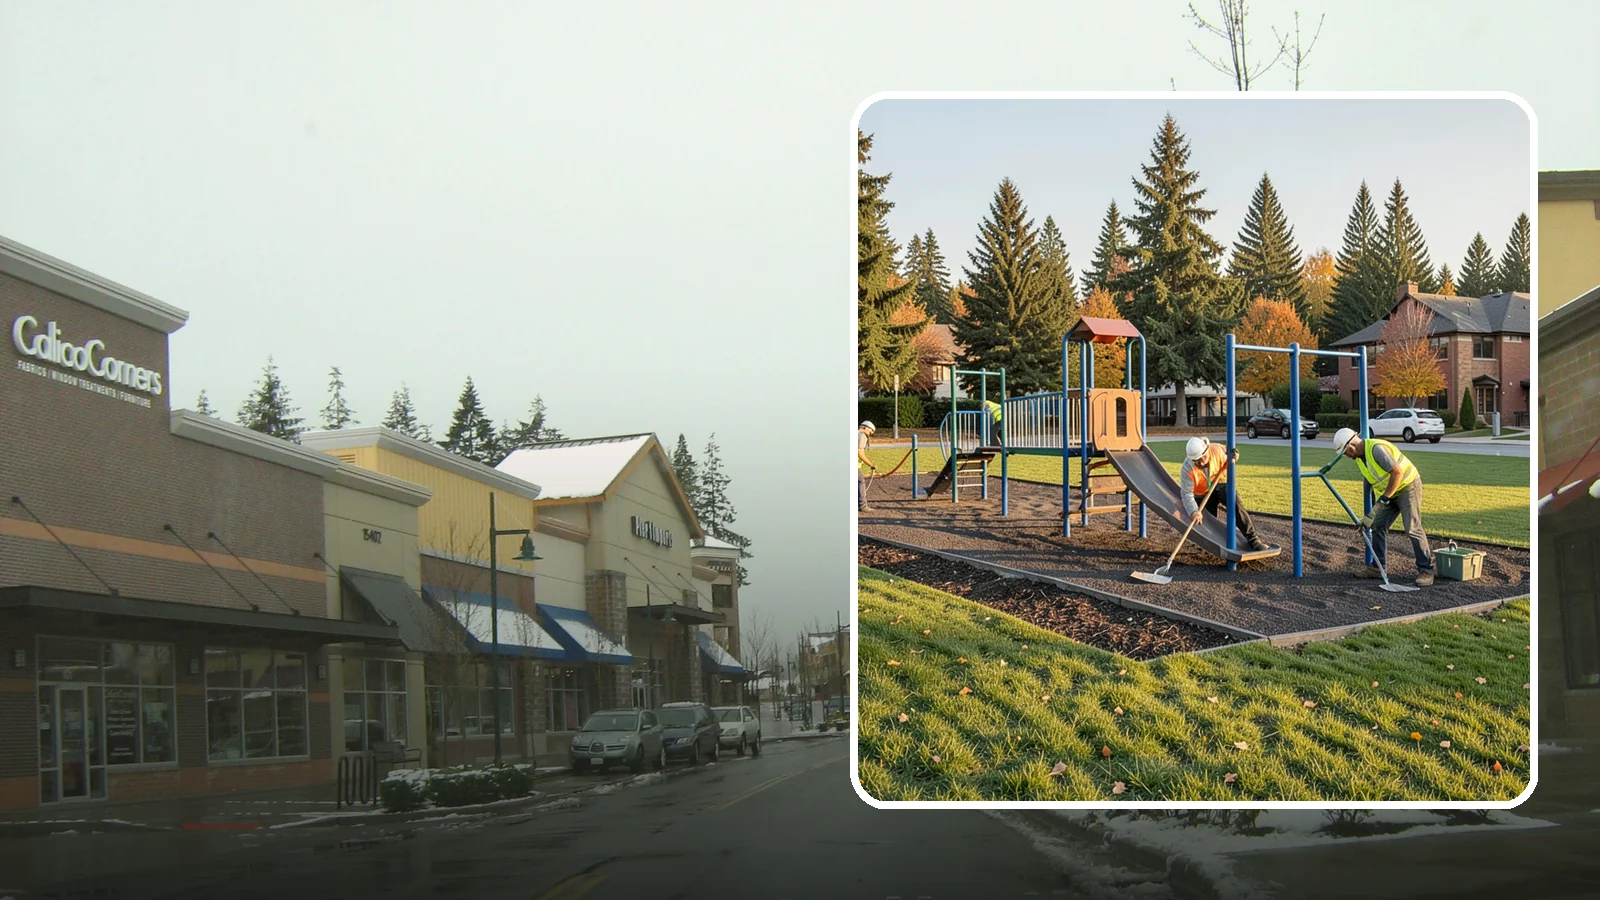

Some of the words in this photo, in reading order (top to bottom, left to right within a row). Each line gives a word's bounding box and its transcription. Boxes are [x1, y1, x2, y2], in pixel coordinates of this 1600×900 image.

[17, 360, 47, 377] FABRICS
[51, 371, 78, 387] WINDOW
[79, 378, 117, 398] TREATMENTS
[120, 391, 151, 408] FURNITURE
